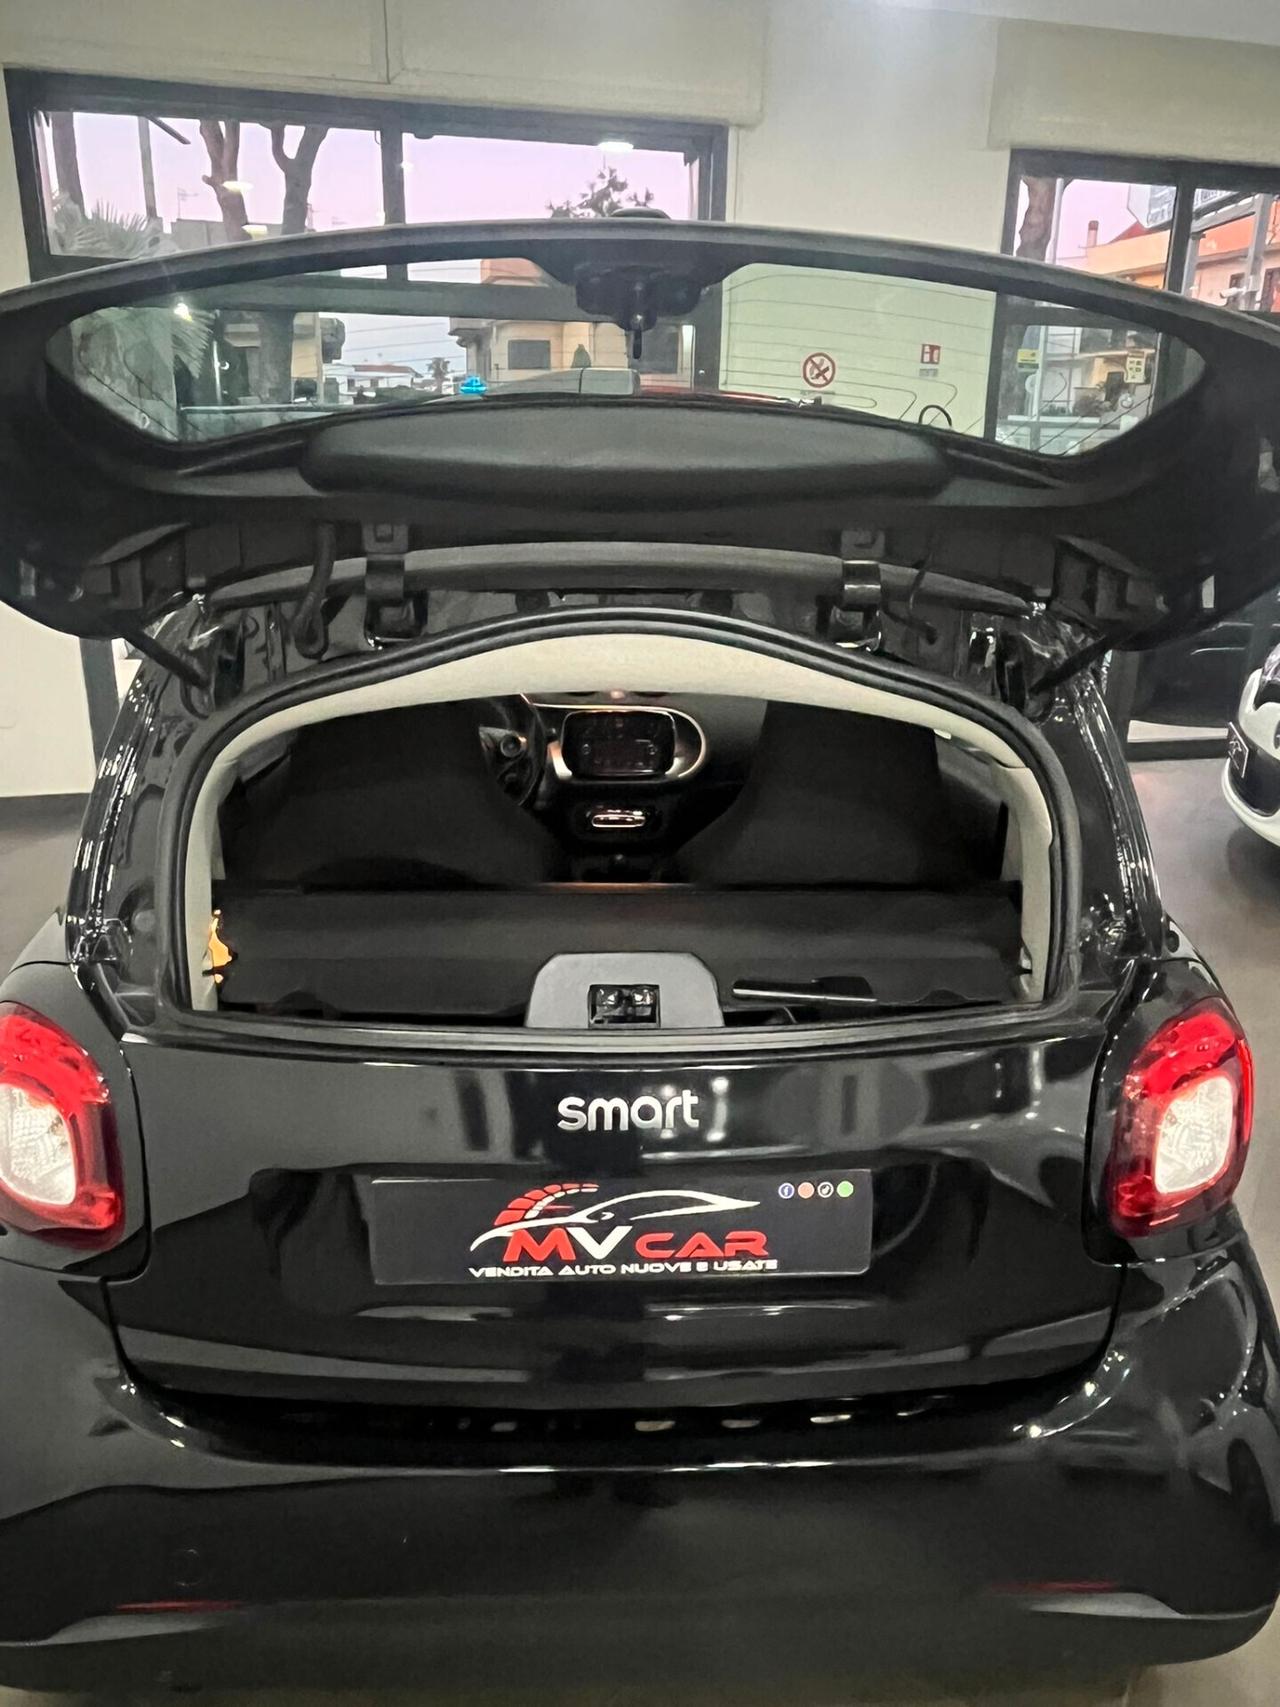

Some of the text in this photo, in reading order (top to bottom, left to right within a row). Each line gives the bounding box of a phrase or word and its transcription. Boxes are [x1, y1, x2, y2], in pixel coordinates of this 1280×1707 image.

[557, 1089, 699, 1131] smart
[503, 1225, 769, 1262] MV CAR
[468, 1259, 778, 1278] VENDITA AUTO NUOVE E USATE
